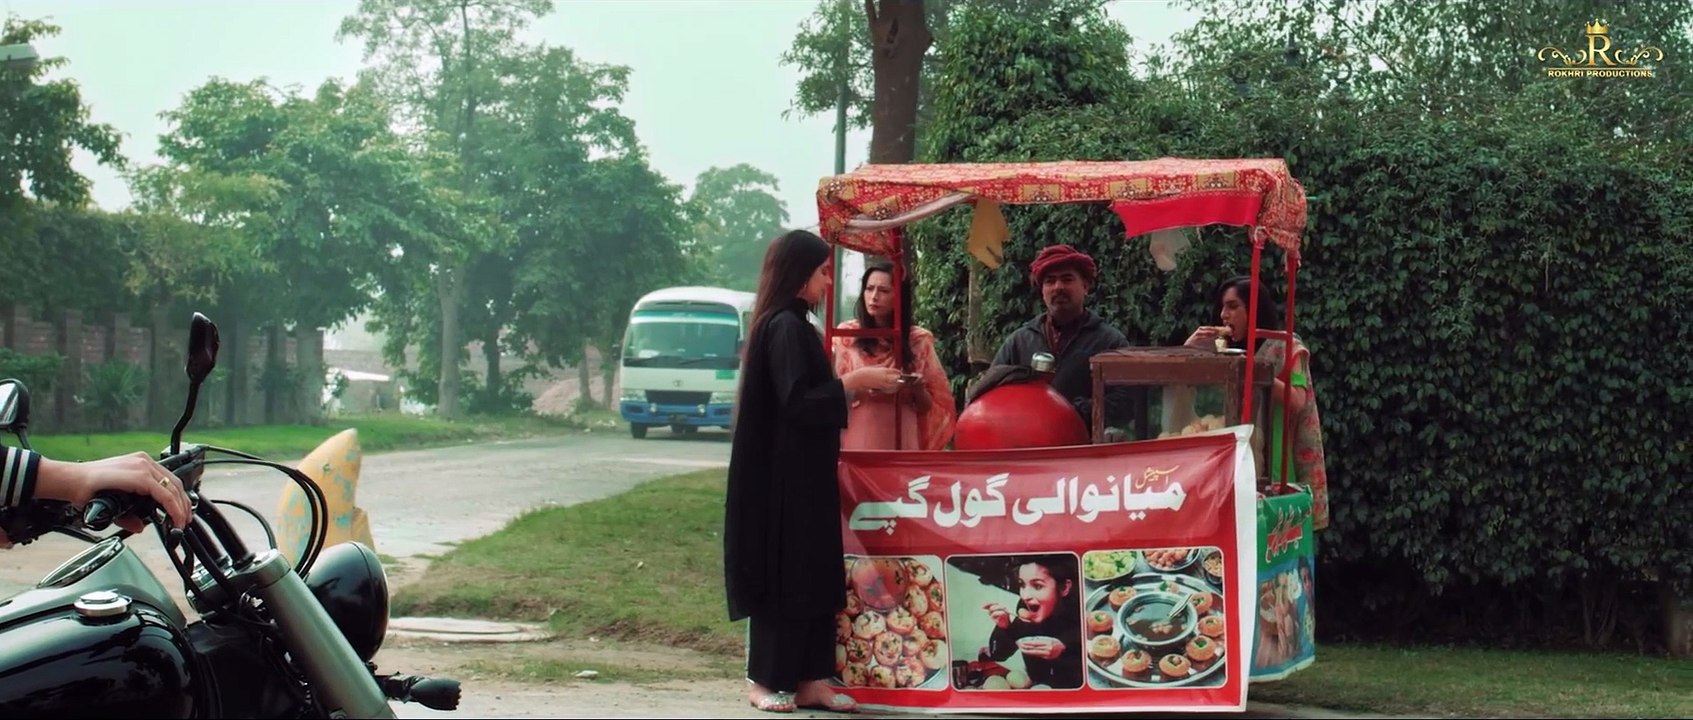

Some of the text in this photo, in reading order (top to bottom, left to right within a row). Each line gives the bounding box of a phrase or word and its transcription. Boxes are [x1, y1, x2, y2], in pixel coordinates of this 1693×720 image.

[848, 473, 1187, 536] میانوالی گول گپے
